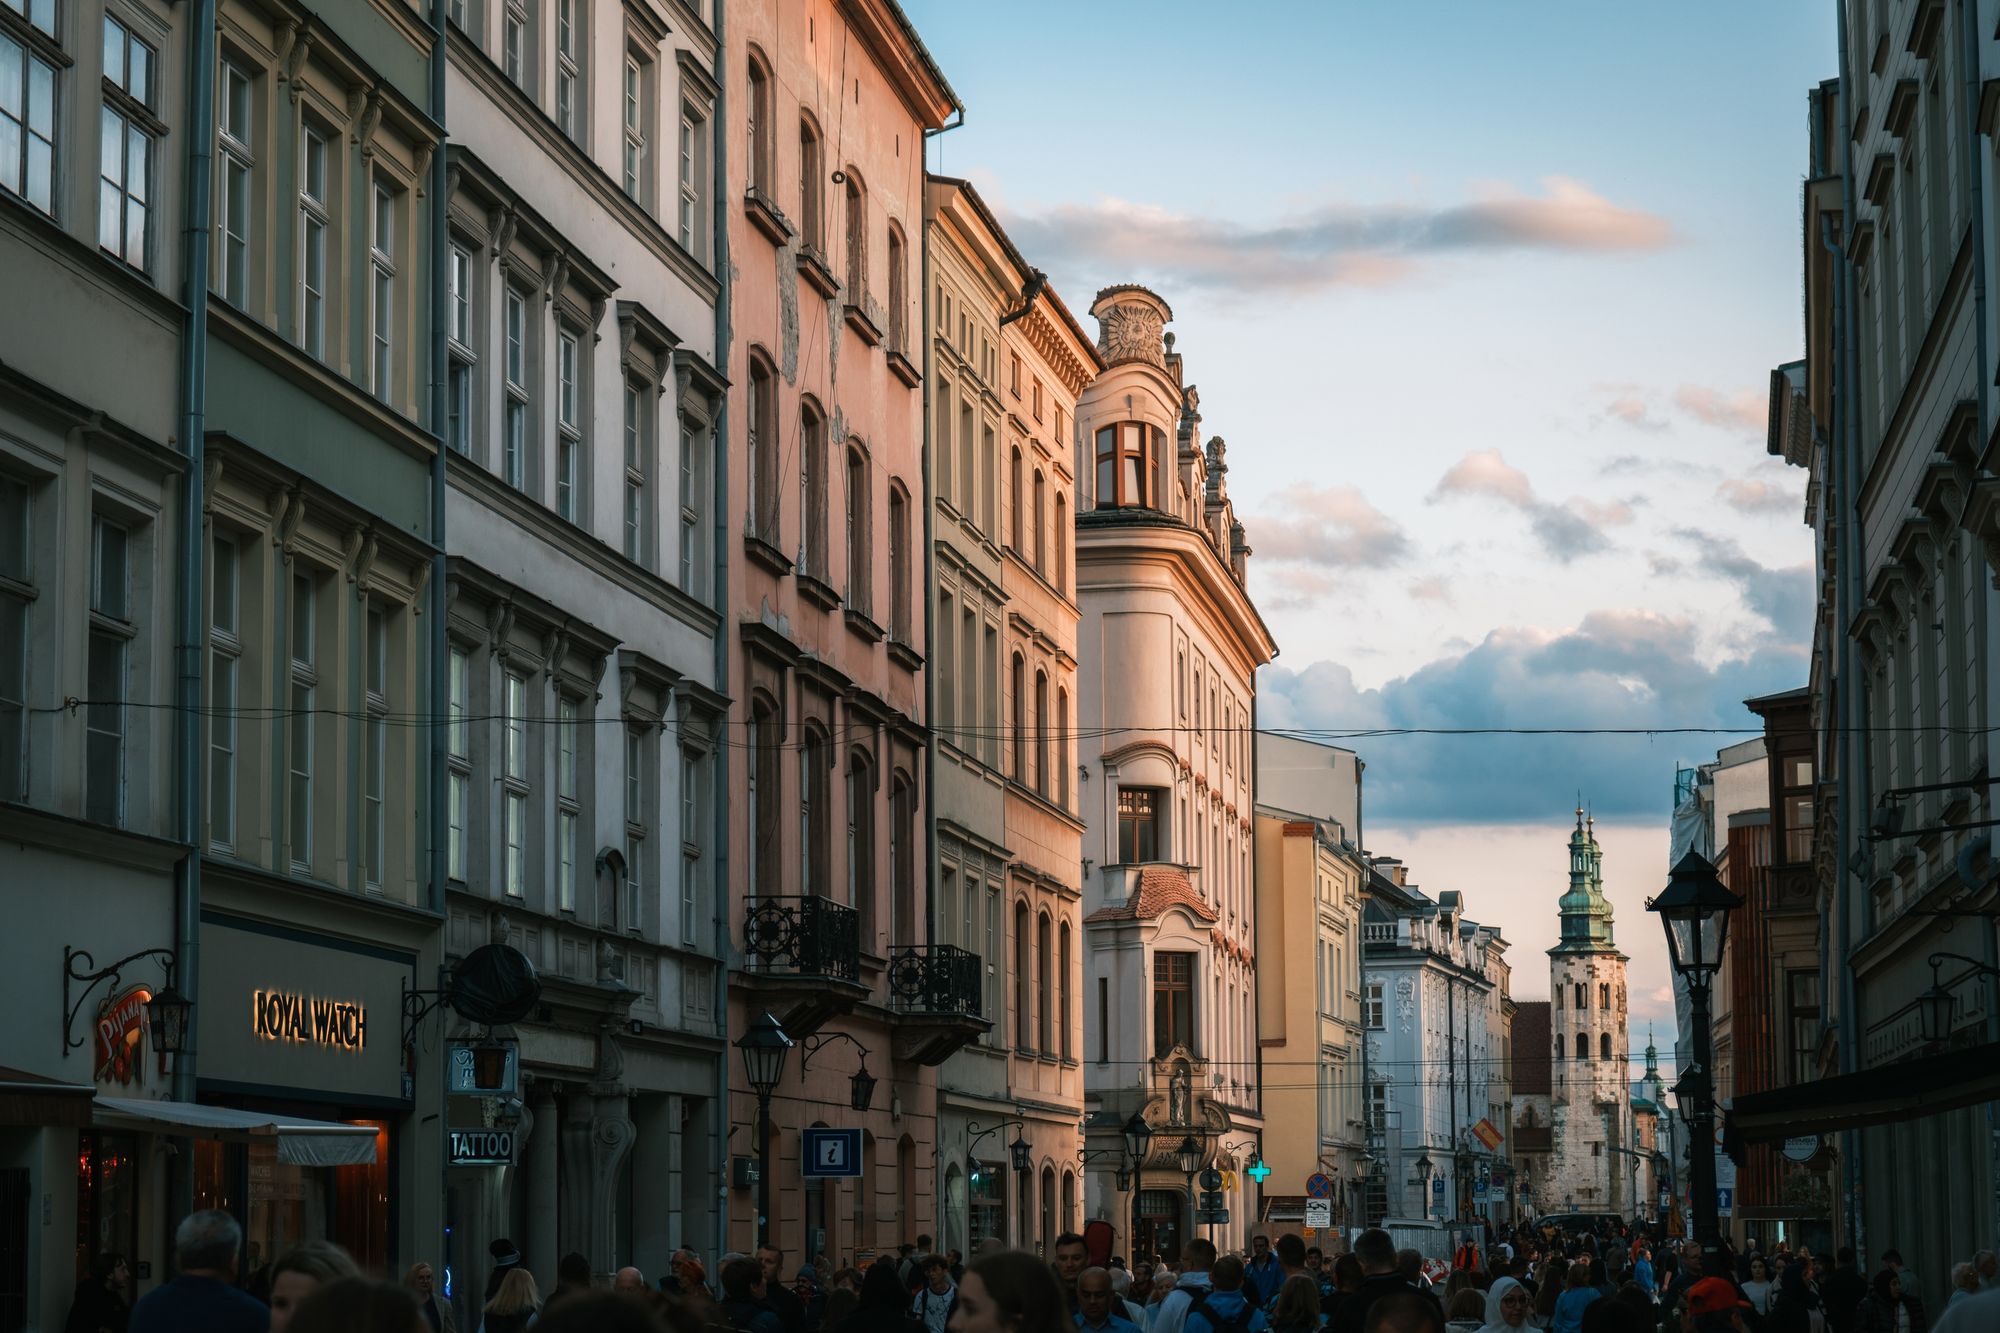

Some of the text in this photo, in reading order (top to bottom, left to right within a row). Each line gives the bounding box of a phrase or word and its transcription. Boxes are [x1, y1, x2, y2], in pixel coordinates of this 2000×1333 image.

[257, 992, 367, 1048] ROYAL WATCH
[451, 1132, 511, 1156] TATTOO
